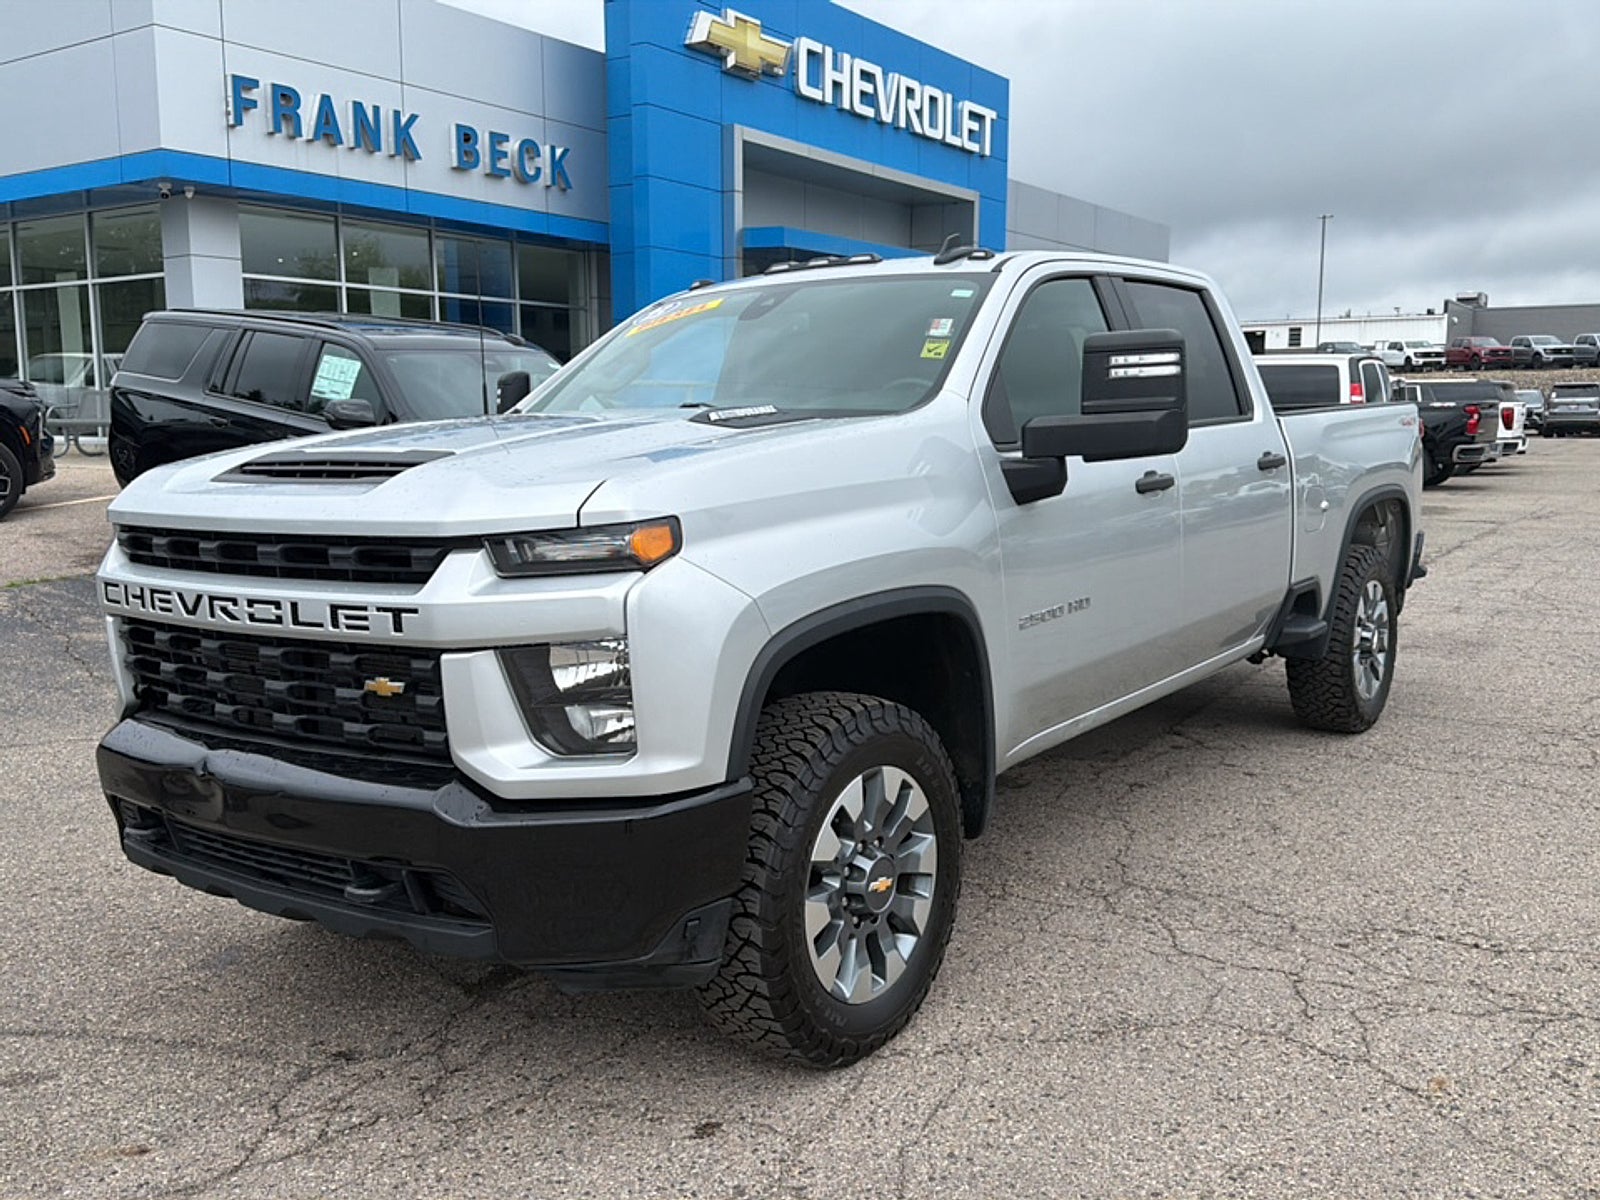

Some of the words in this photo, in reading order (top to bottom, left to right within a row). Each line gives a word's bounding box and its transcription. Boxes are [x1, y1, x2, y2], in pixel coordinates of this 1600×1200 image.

[228, 74, 422, 161] FRANK
[451, 123, 574, 191] BECK
[794, 37, 997, 156] CHEVROLET
[103, 581, 419, 635] CHEVROLET
